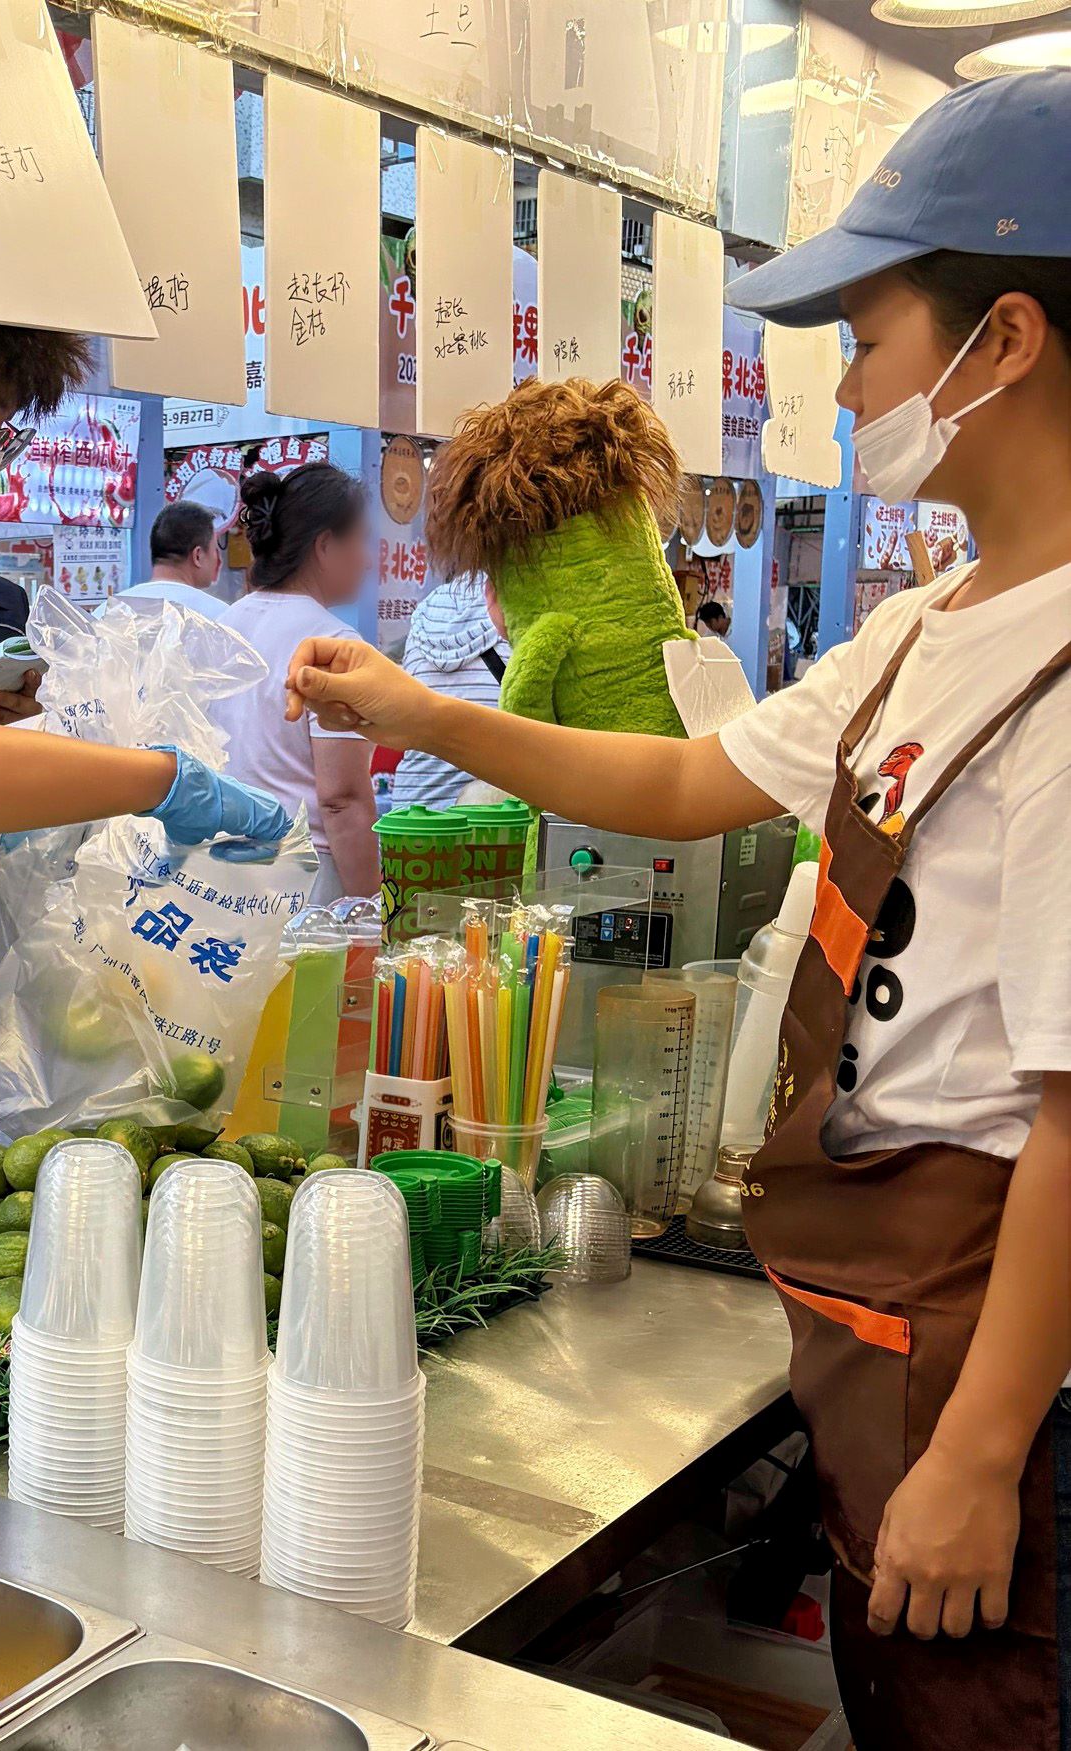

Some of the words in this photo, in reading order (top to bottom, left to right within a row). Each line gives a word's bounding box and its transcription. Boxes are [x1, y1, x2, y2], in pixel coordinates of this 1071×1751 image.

[398, 356, 416, 382] 20
[31, 437, 133, 473] 鲜榨西瓜汁
